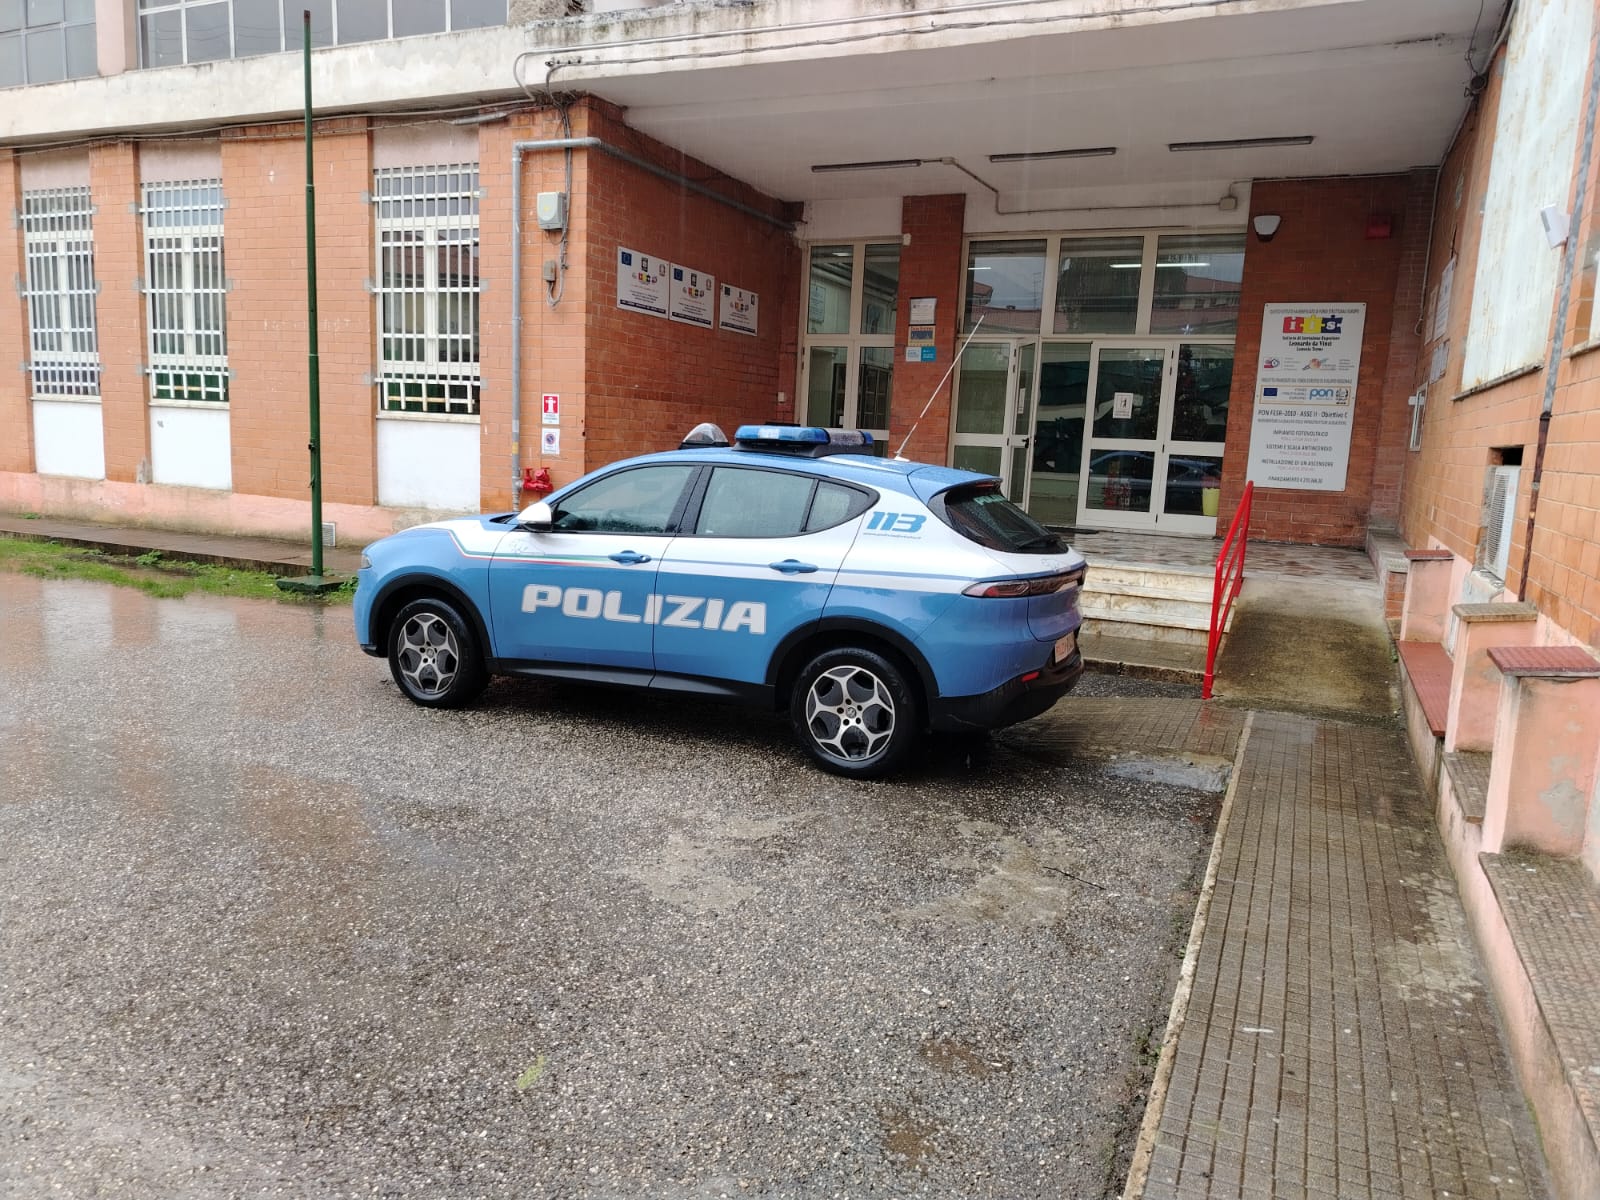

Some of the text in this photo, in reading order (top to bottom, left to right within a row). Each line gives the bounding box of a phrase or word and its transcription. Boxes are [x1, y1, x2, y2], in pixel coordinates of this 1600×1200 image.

[1309, 388, 1334, 400] pon
[866, 511, 927, 533] 113
[521, 584, 767, 635] POLIZIA
